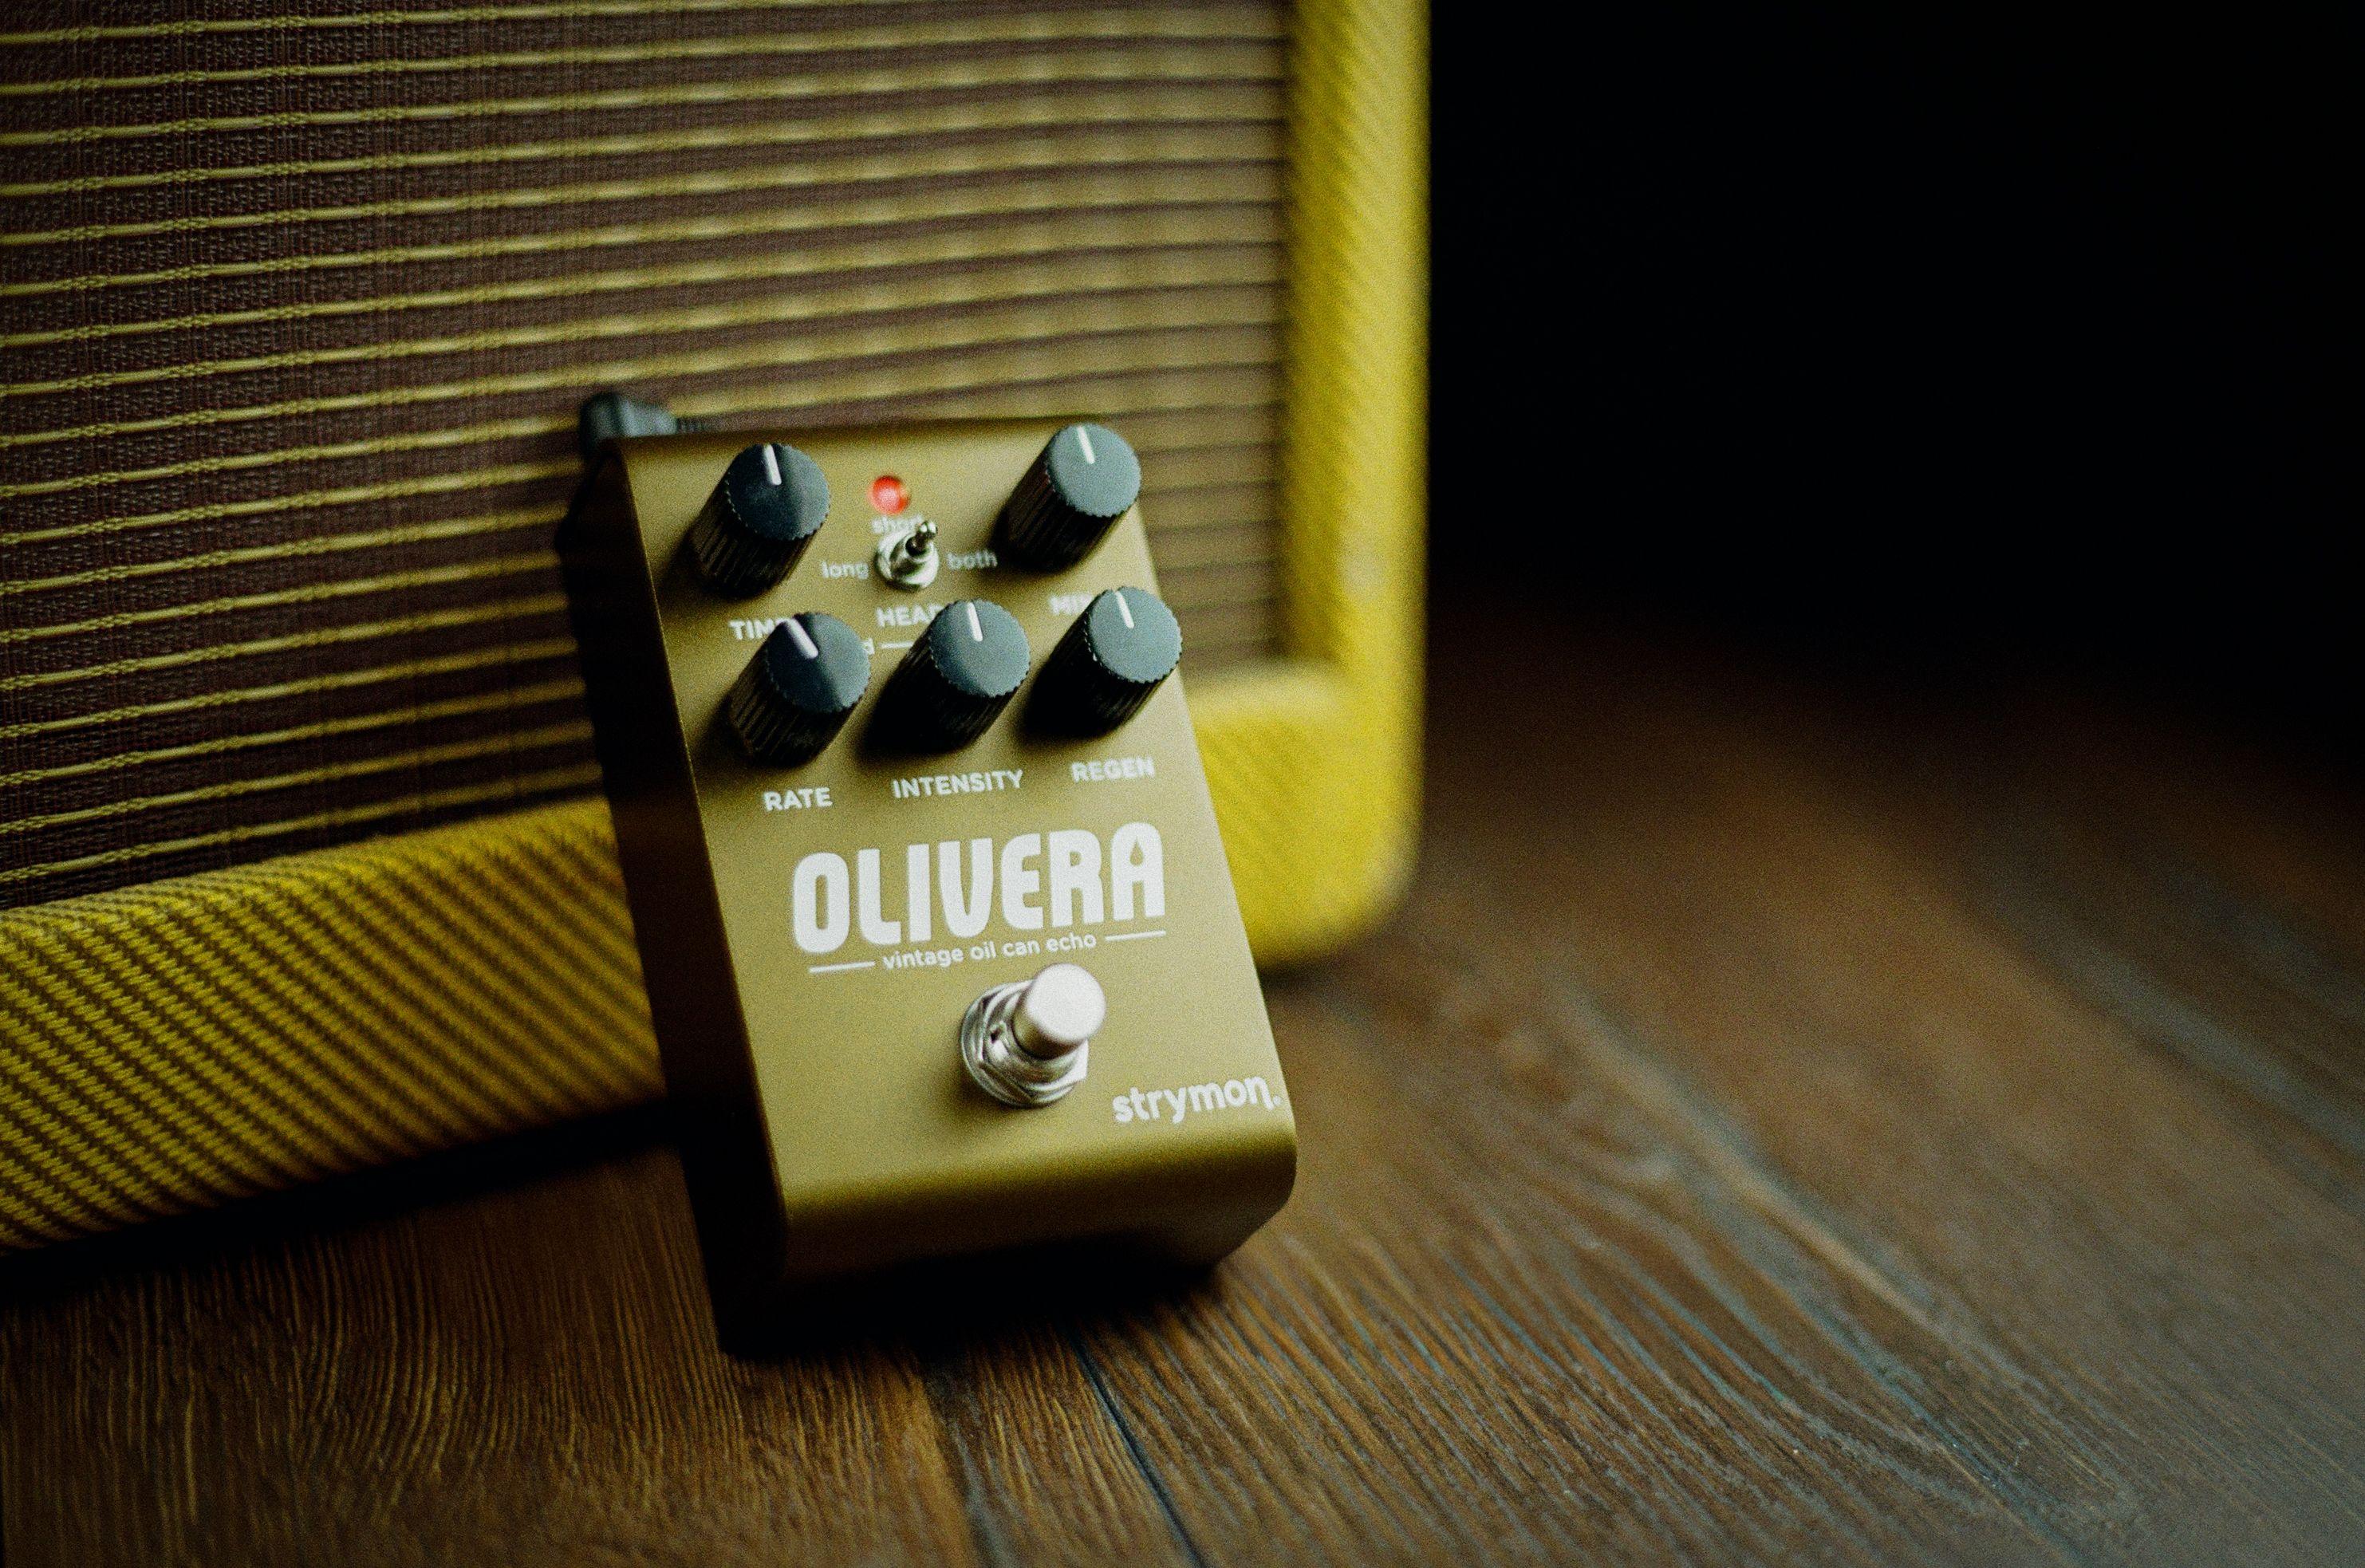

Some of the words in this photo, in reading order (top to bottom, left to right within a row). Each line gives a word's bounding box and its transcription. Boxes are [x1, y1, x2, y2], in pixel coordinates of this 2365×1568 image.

[822, 561, 869, 580] long
[947, 550, 997, 569] both
[728, 617, 783, 640] TIM
[1071, 758, 1155, 783] REGEN
[892, 770, 1023, 798] INTENSITY
[763, 786, 833, 812] RATE
[793, 821, 1166, 954] OLIVERA
[882, 949, 964, 970] vintage
[970, 941, 996, 960] oil
[1002, 940, 1040, 956] can
[1046, 932, 1097, 952] echo
